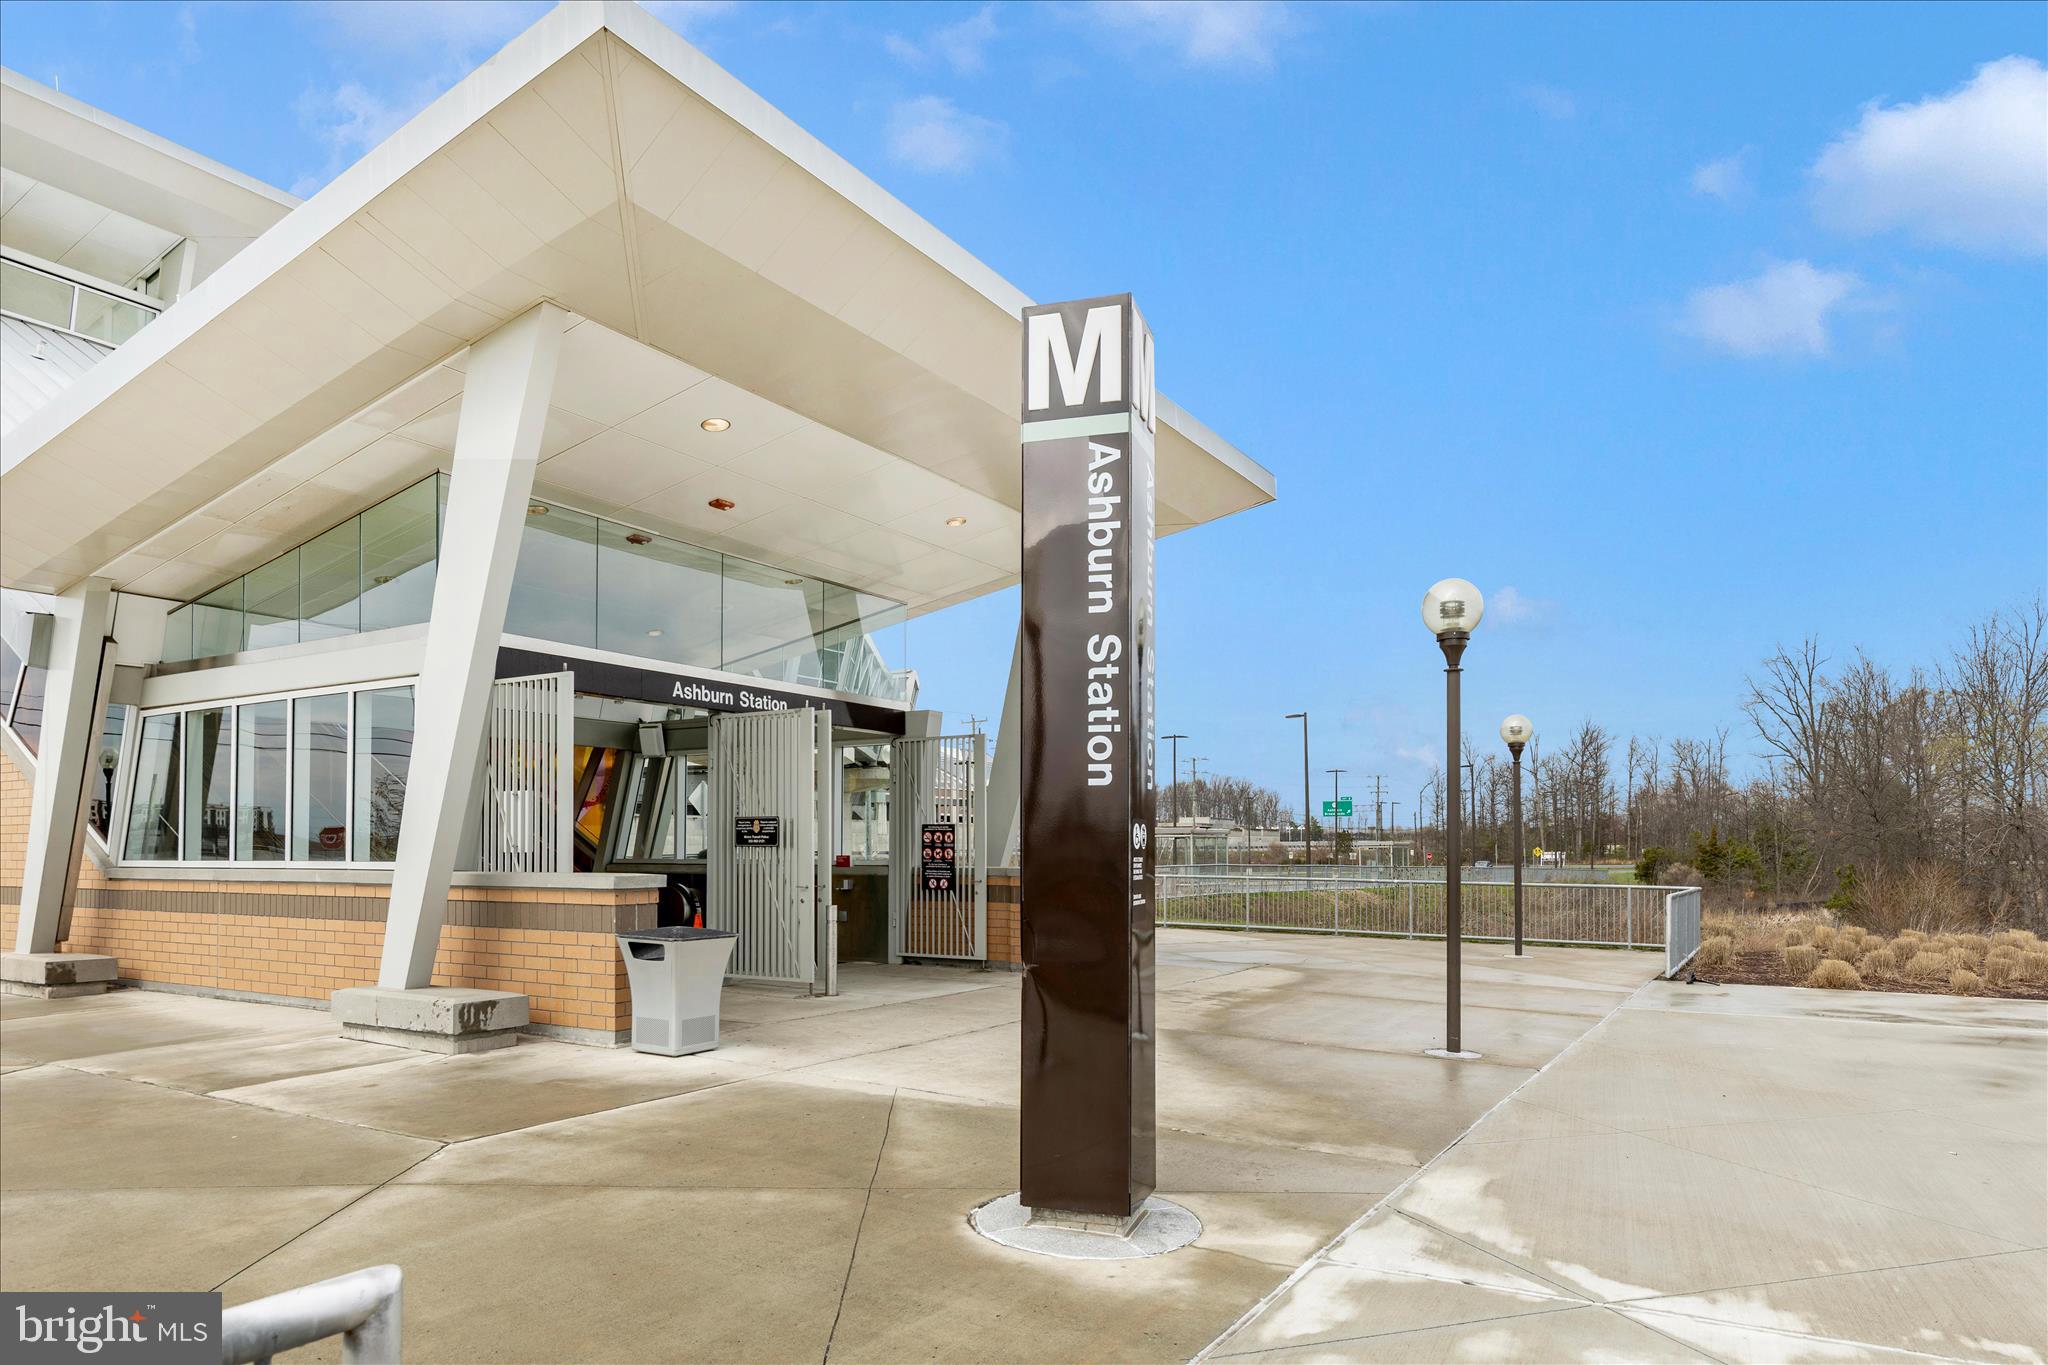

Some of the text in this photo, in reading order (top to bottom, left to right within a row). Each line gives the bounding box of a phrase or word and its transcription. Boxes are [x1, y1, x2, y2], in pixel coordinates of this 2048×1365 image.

[1028, 304, 1122, 410] M
[1131, 304, 1156, 434] M
[1087, 441, 1122, 786] Ashburn Station
[1146, 462, 1155, 790] Ashburn Station
[672, 681, 788, 711] Ashburn Station
